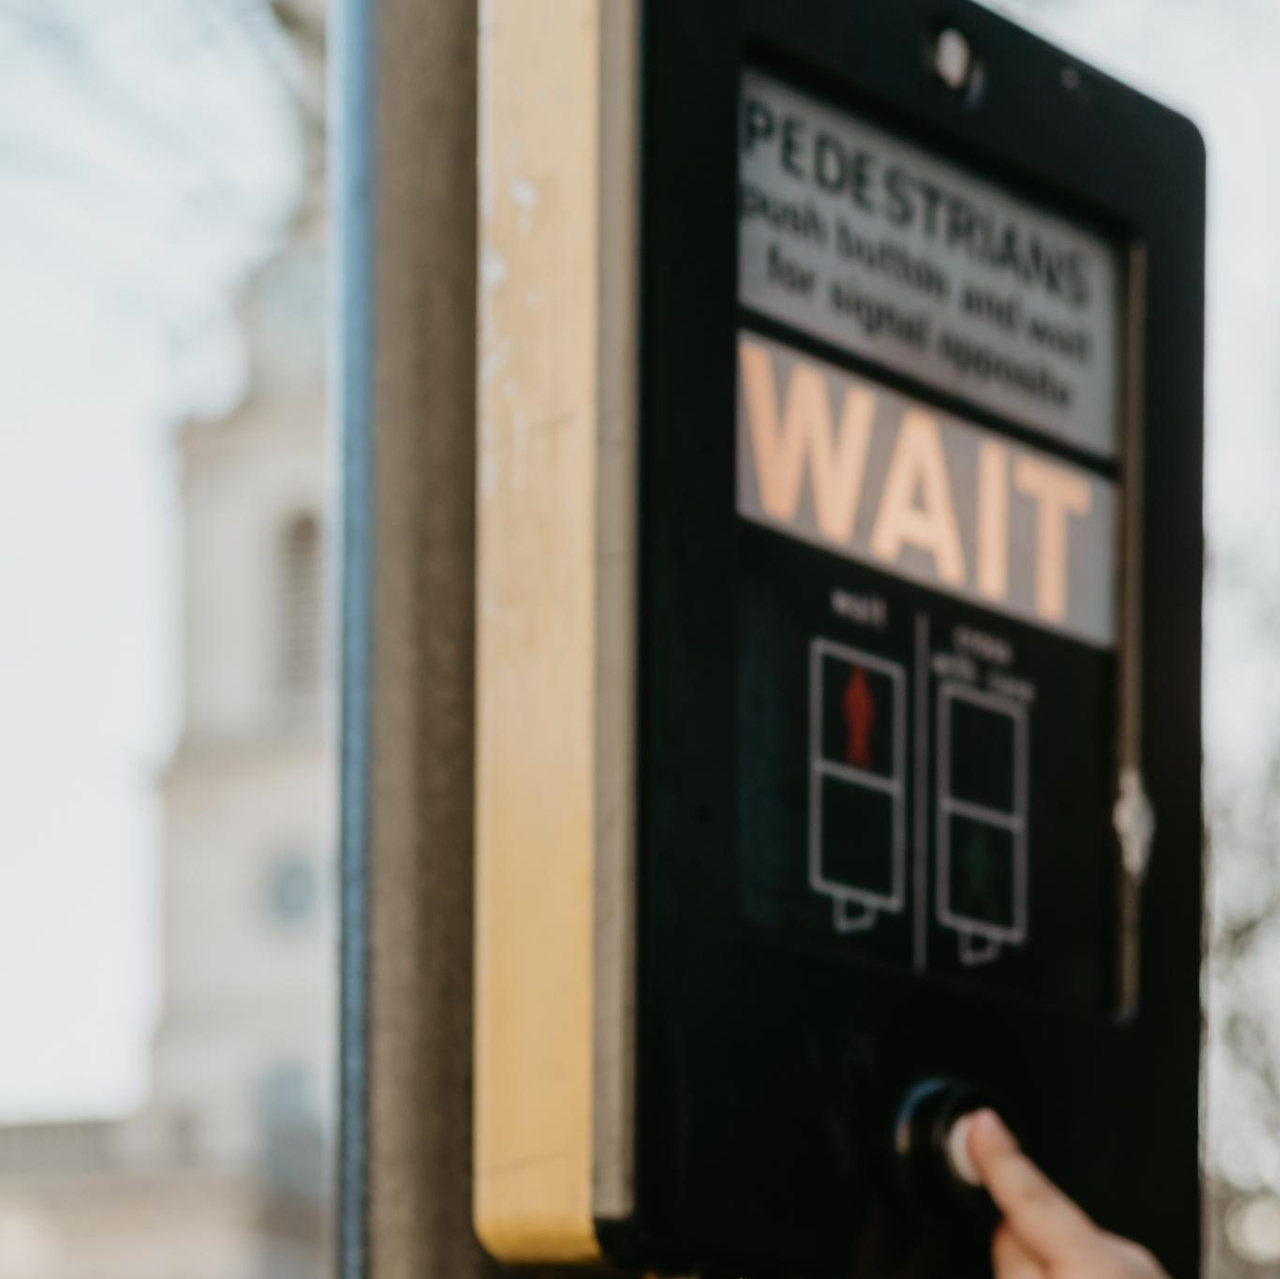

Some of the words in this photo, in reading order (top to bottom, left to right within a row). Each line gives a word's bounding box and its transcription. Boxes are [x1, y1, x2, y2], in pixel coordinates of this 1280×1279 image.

[744, 100, 1091, 309] PEDESTRIANS
[835, 213, 949, 298] button
[960, 282, 1024, 331] and
[1026, 317, 1090, 366] wait
[766, 243, 816, 298] for
[828, 280, 929, 348] signal
[936, 327, 1072, 409] opposite
[738, 341, 1092, 624] WAIT
